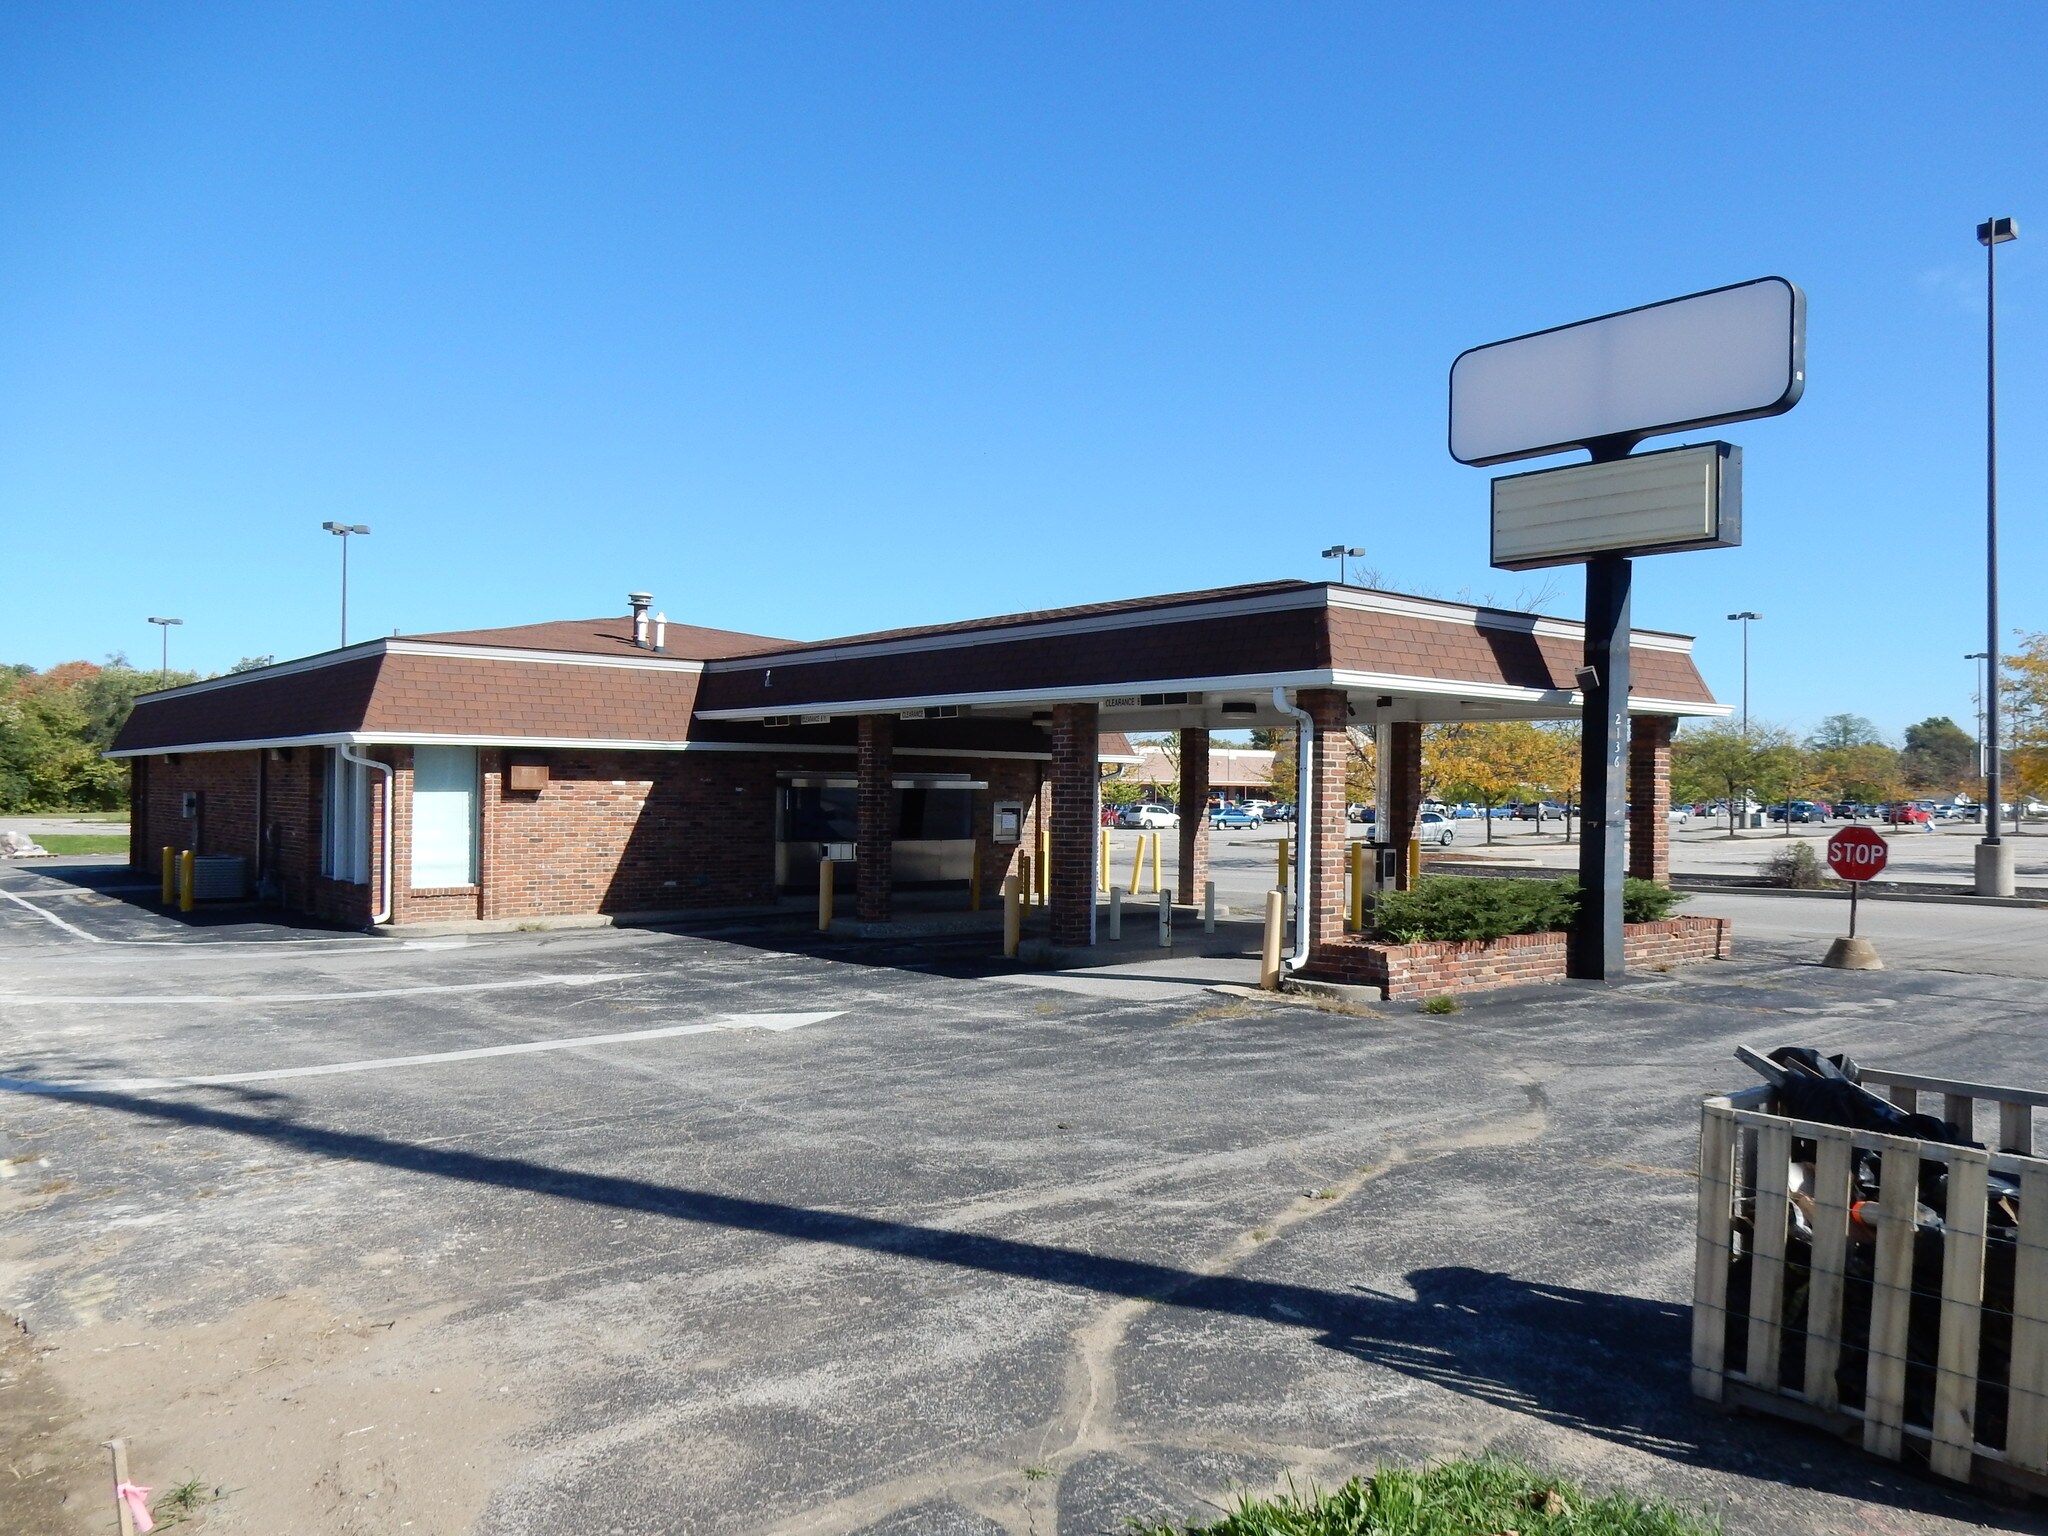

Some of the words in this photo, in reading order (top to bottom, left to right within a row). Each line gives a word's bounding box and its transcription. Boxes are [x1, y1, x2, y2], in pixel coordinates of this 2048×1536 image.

[1105, 697, 1135, 708] CLEARANCE
[902, 710, 924, 719] CLEARANCE
[1829, 842, 1884, 865] STOP
